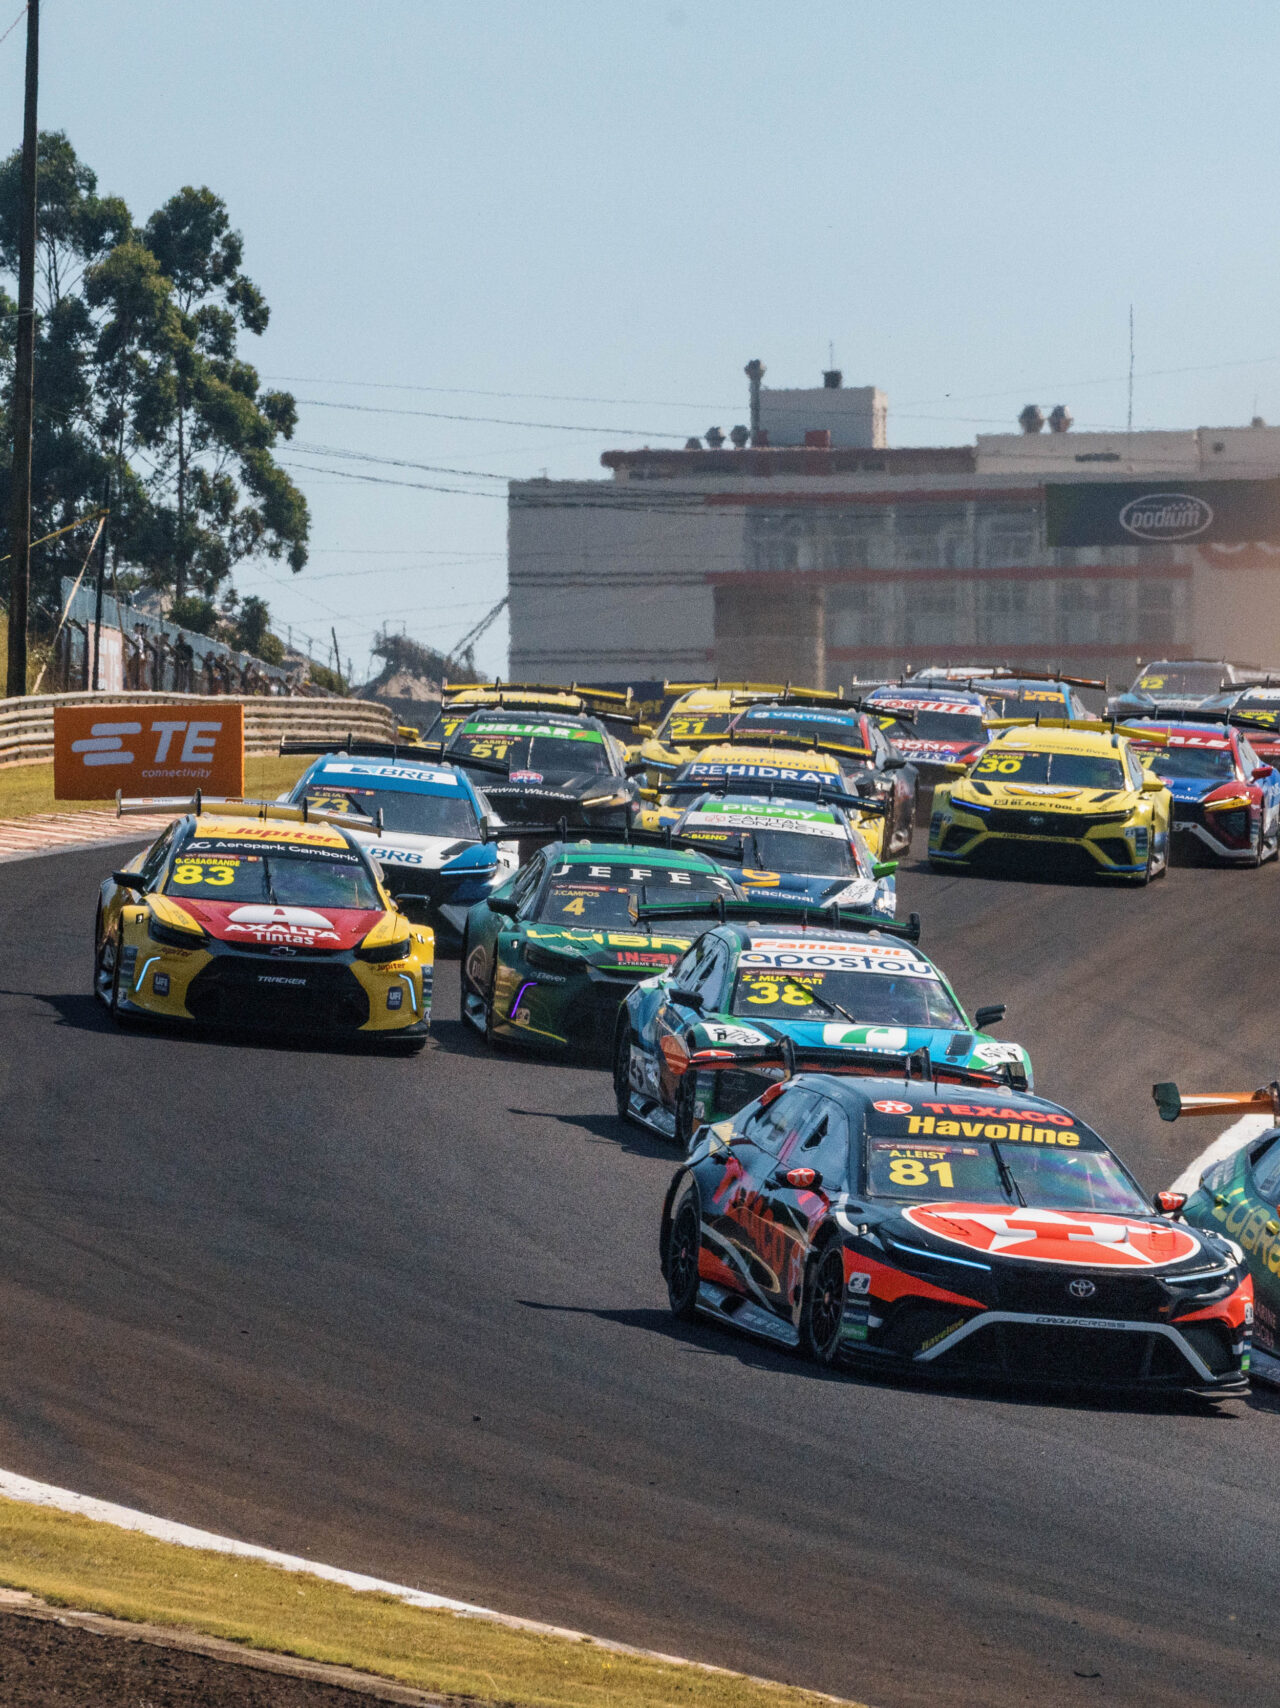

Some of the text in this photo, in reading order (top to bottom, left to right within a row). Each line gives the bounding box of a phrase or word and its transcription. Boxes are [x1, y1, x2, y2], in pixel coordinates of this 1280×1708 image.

[1130, 504, 1200, 529] podium
[1139, 679, 1164, 689] 12
[772, 712, 847, 725] VENTISOL
[475, 723, 571, 738] HELIAR
[669, 721, 707, 735] 21
[151, 721, 223, 763] TE
[468, 744, 509, 760] 51
[711, 756, 820, 770] eurofarma
[976, 759, 1022, 774] 30
[141, 767, 212, 779] connectivity
[379, 767, 434, 782] BRB
[689, 764, 836, 785] REHIDRAT
[306, 796, 350, 813] 73
[229, 827, 341, 844] Jupiter
[216, 841, 286, 852] Aeropark
[369, 847, 423, 865] BRB
[172, 864, 236, 886] 83
[751, 888, 815, 904] nacional
[562, 897, 585, 916] 4
[223, 924, 341, 941] AXALTA
[253, 931, 314, 946] Tintas
[526, 929, 693, 951] LUBR
[257, 975, 306, 985] TRACKER
[746, 981, 814, 1006] 38
[920, 1102, 1075, 1127] TEXACO
[905, 1114, 1080, 1147] Havoline
[889, 1149, 946, 1161] A.LEIST
[888, 1159, 955, 1188] 81
